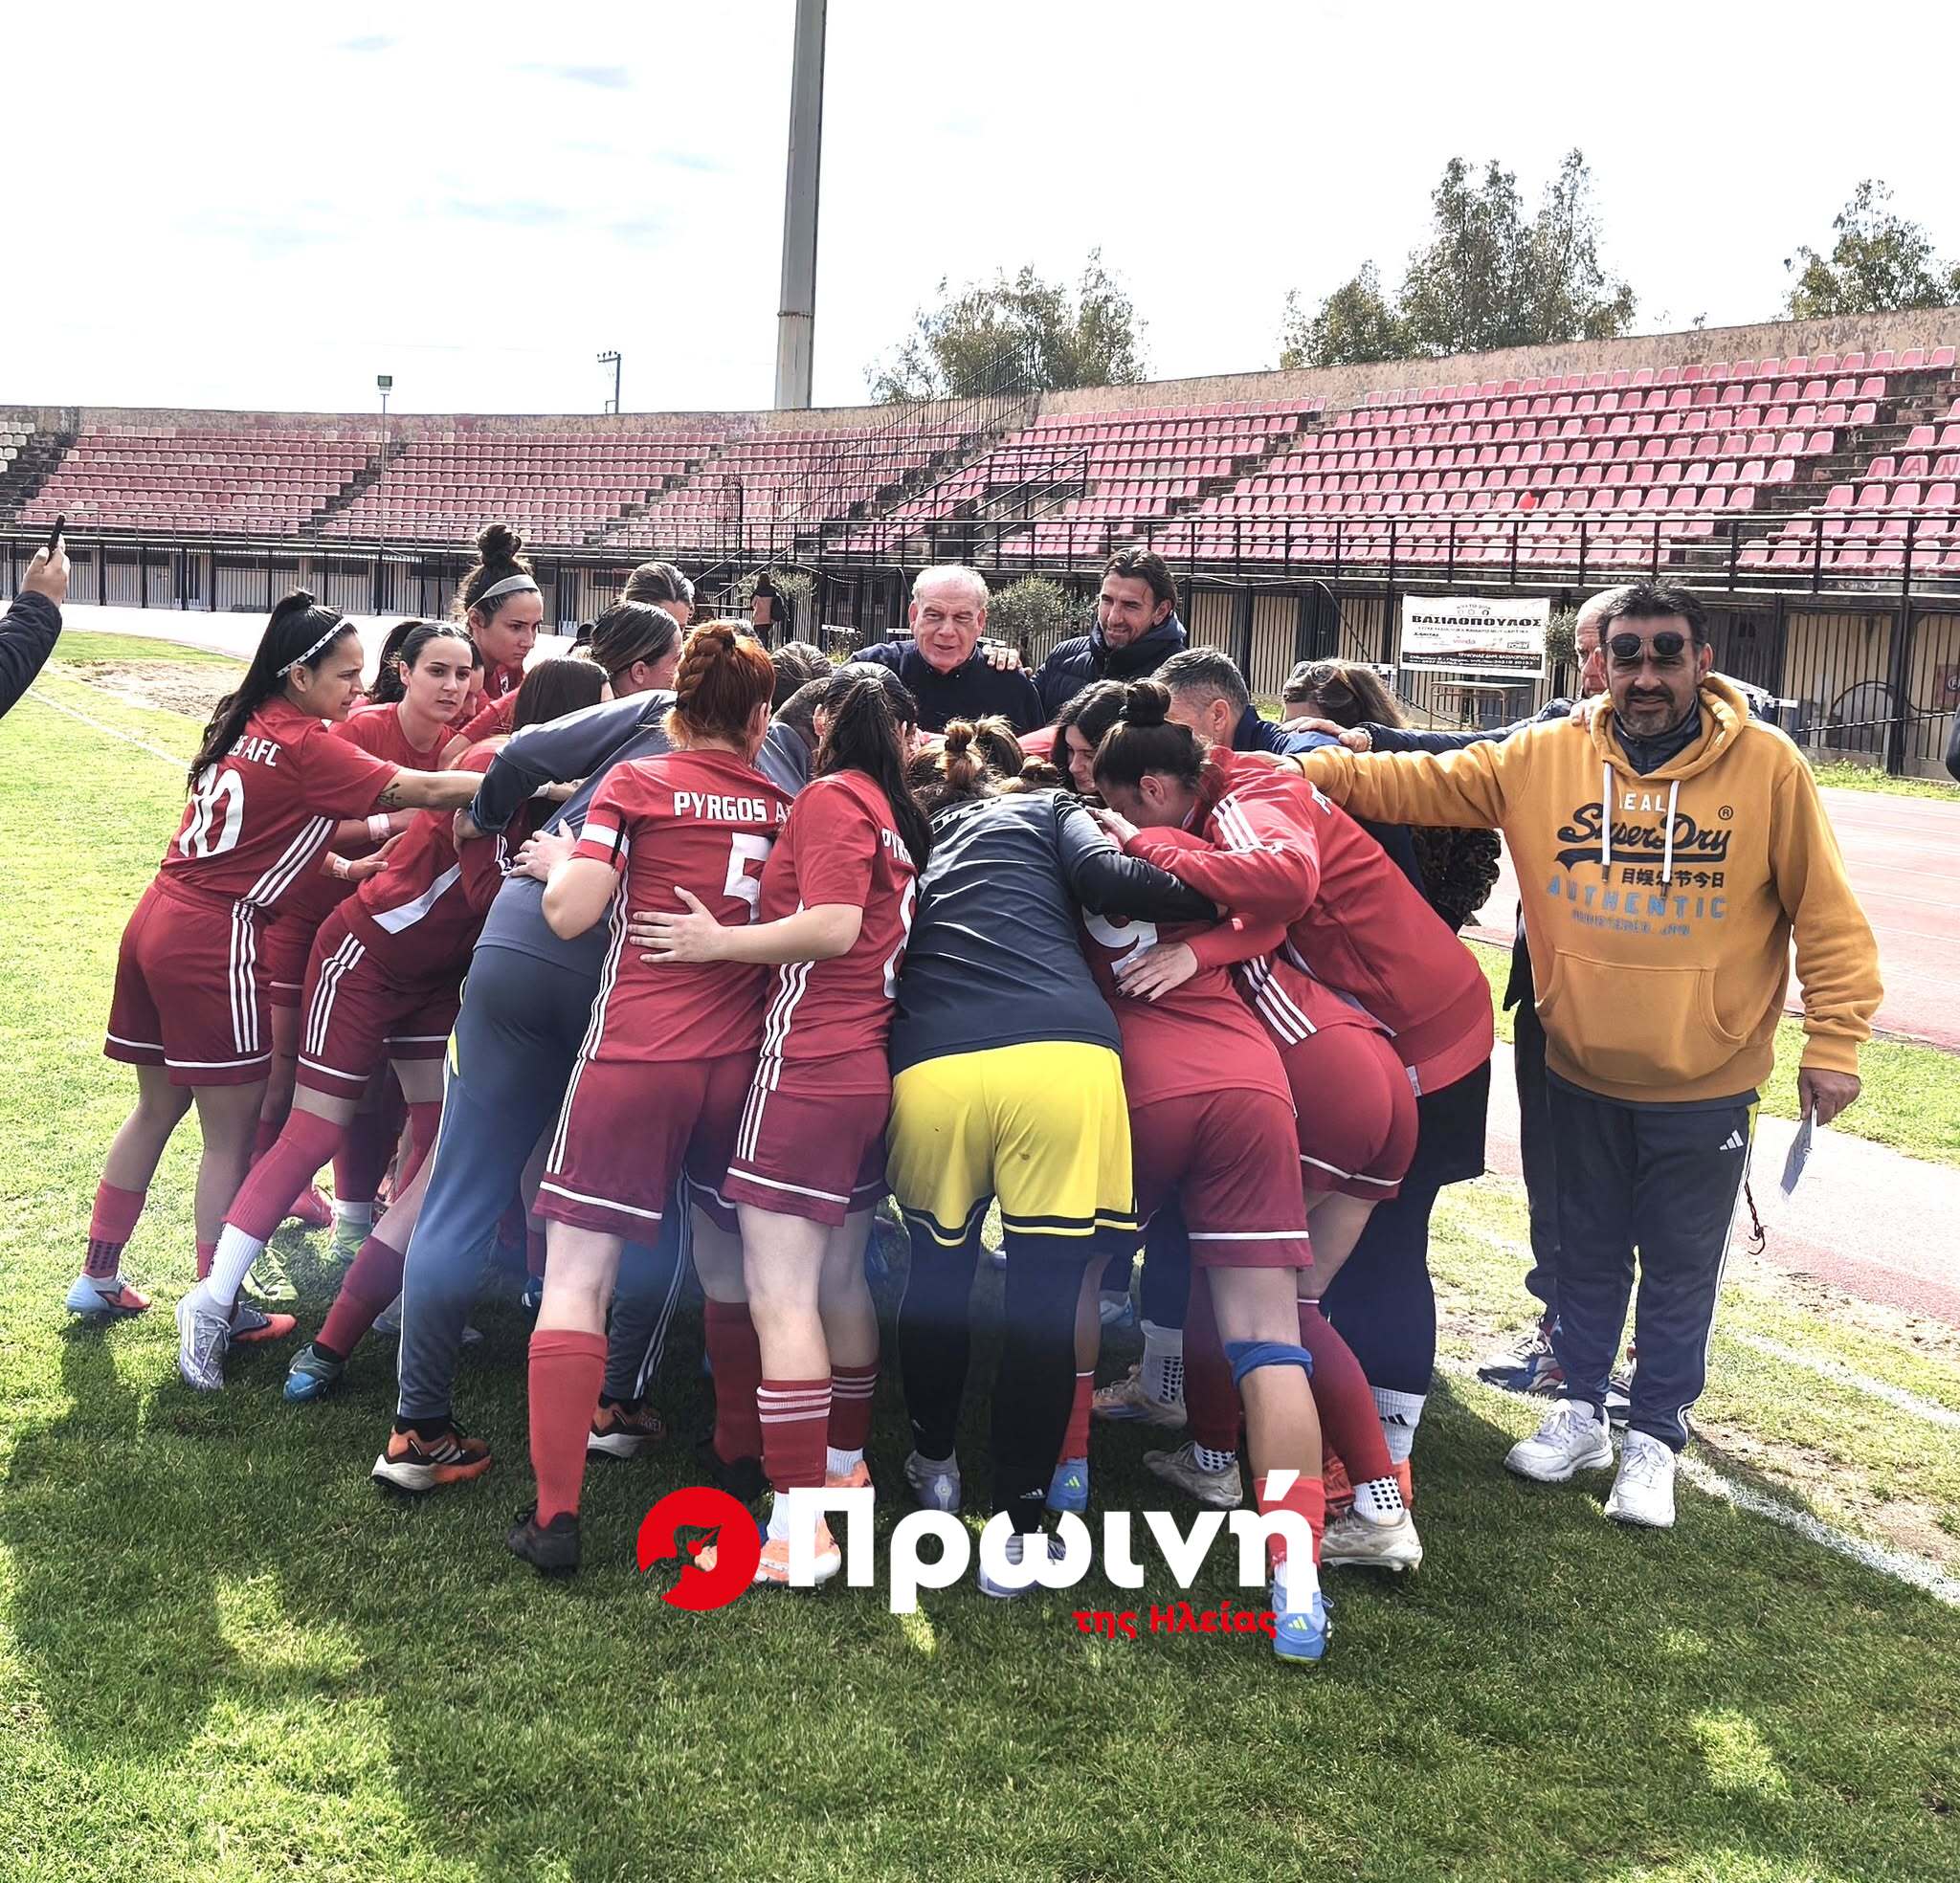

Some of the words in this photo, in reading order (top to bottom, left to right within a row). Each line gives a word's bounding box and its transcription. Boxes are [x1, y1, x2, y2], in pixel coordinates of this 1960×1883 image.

[1412, 615, 1542, 627] ΒΑΣΙΛΟΠΟΥΛΟΣ
[241, 736, 282, 767] AFC
[178, 763, 245, 858] 10
[673, 791, 768, 822] PYRGOS
[1618, 792, 1667, 812] EAL
[1557, 802, 1732, 852] SperDry
[1547, 875, 1728, 919] AUTHENTIC
